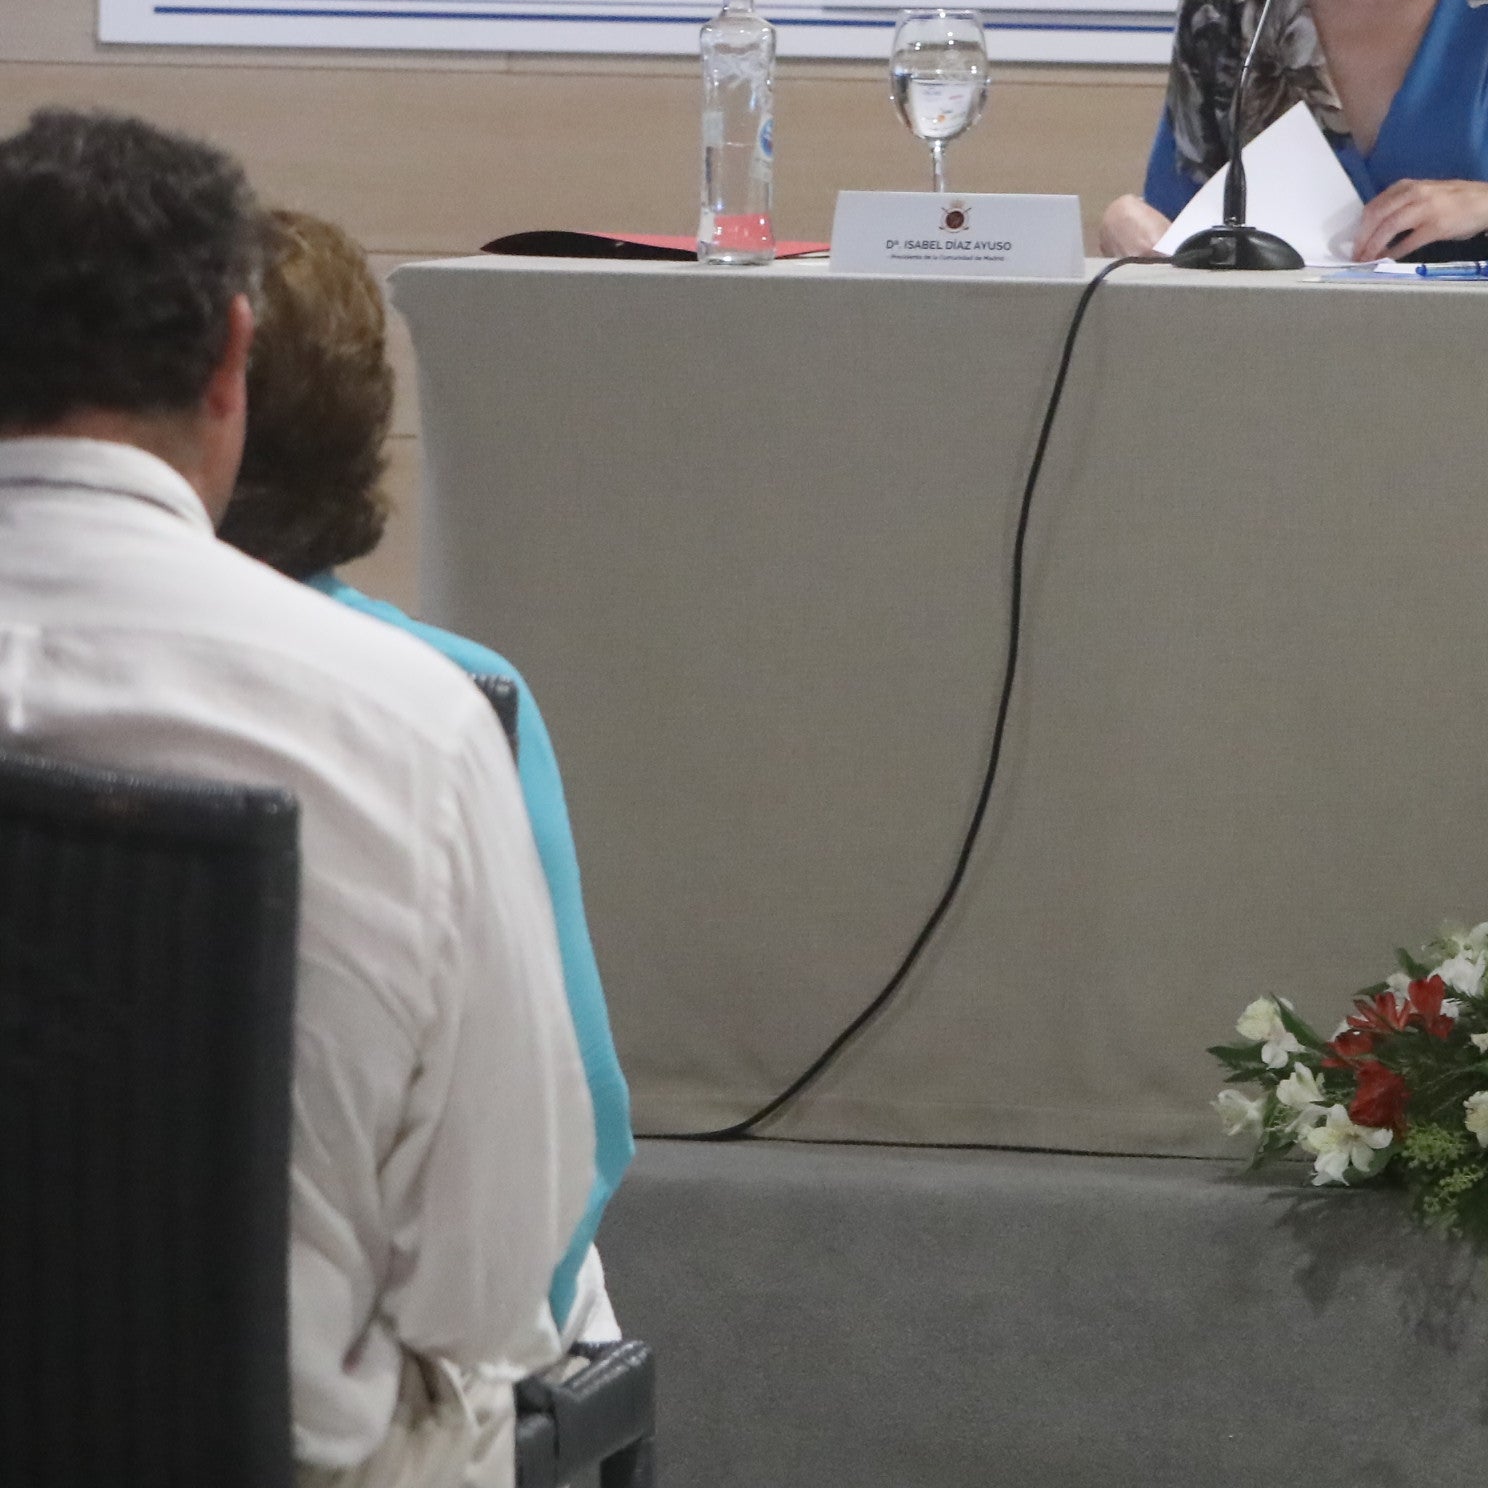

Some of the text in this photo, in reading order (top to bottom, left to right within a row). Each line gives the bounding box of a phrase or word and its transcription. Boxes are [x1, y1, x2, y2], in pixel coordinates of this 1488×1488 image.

[904, 240, 942, 249] ISABEL
[946, 240, 971, 250] DÍAZ
[974, 242, 1012, 250] AYUSO
